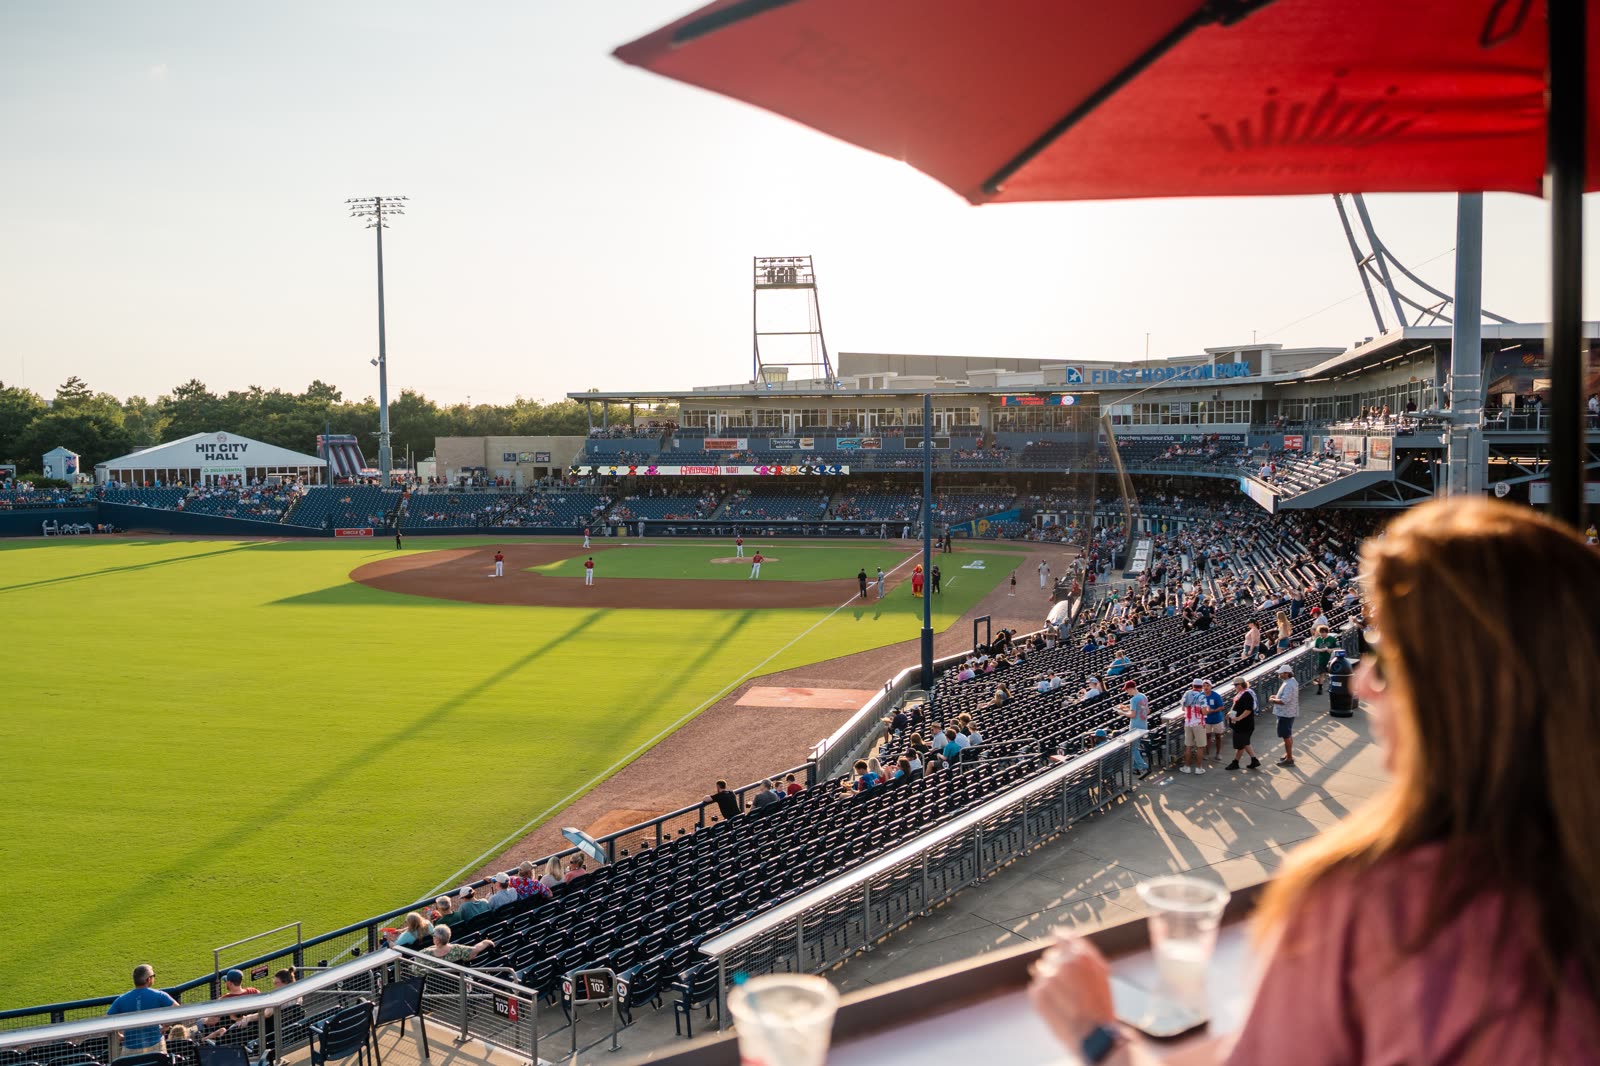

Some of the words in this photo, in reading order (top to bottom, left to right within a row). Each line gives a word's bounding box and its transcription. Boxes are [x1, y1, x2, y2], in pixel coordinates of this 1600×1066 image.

[1092, 369, 1138, 384] FIRST
[1141, 364, 1213, 383] HORIZON
[1215, 361, 1250, 379] PARK
[196, 444, 216, 453] HIT
[219, 444, 248, 453] CITY
[591, 983, 606, 993] 102
[496, 1002, 508, 1014] 102
